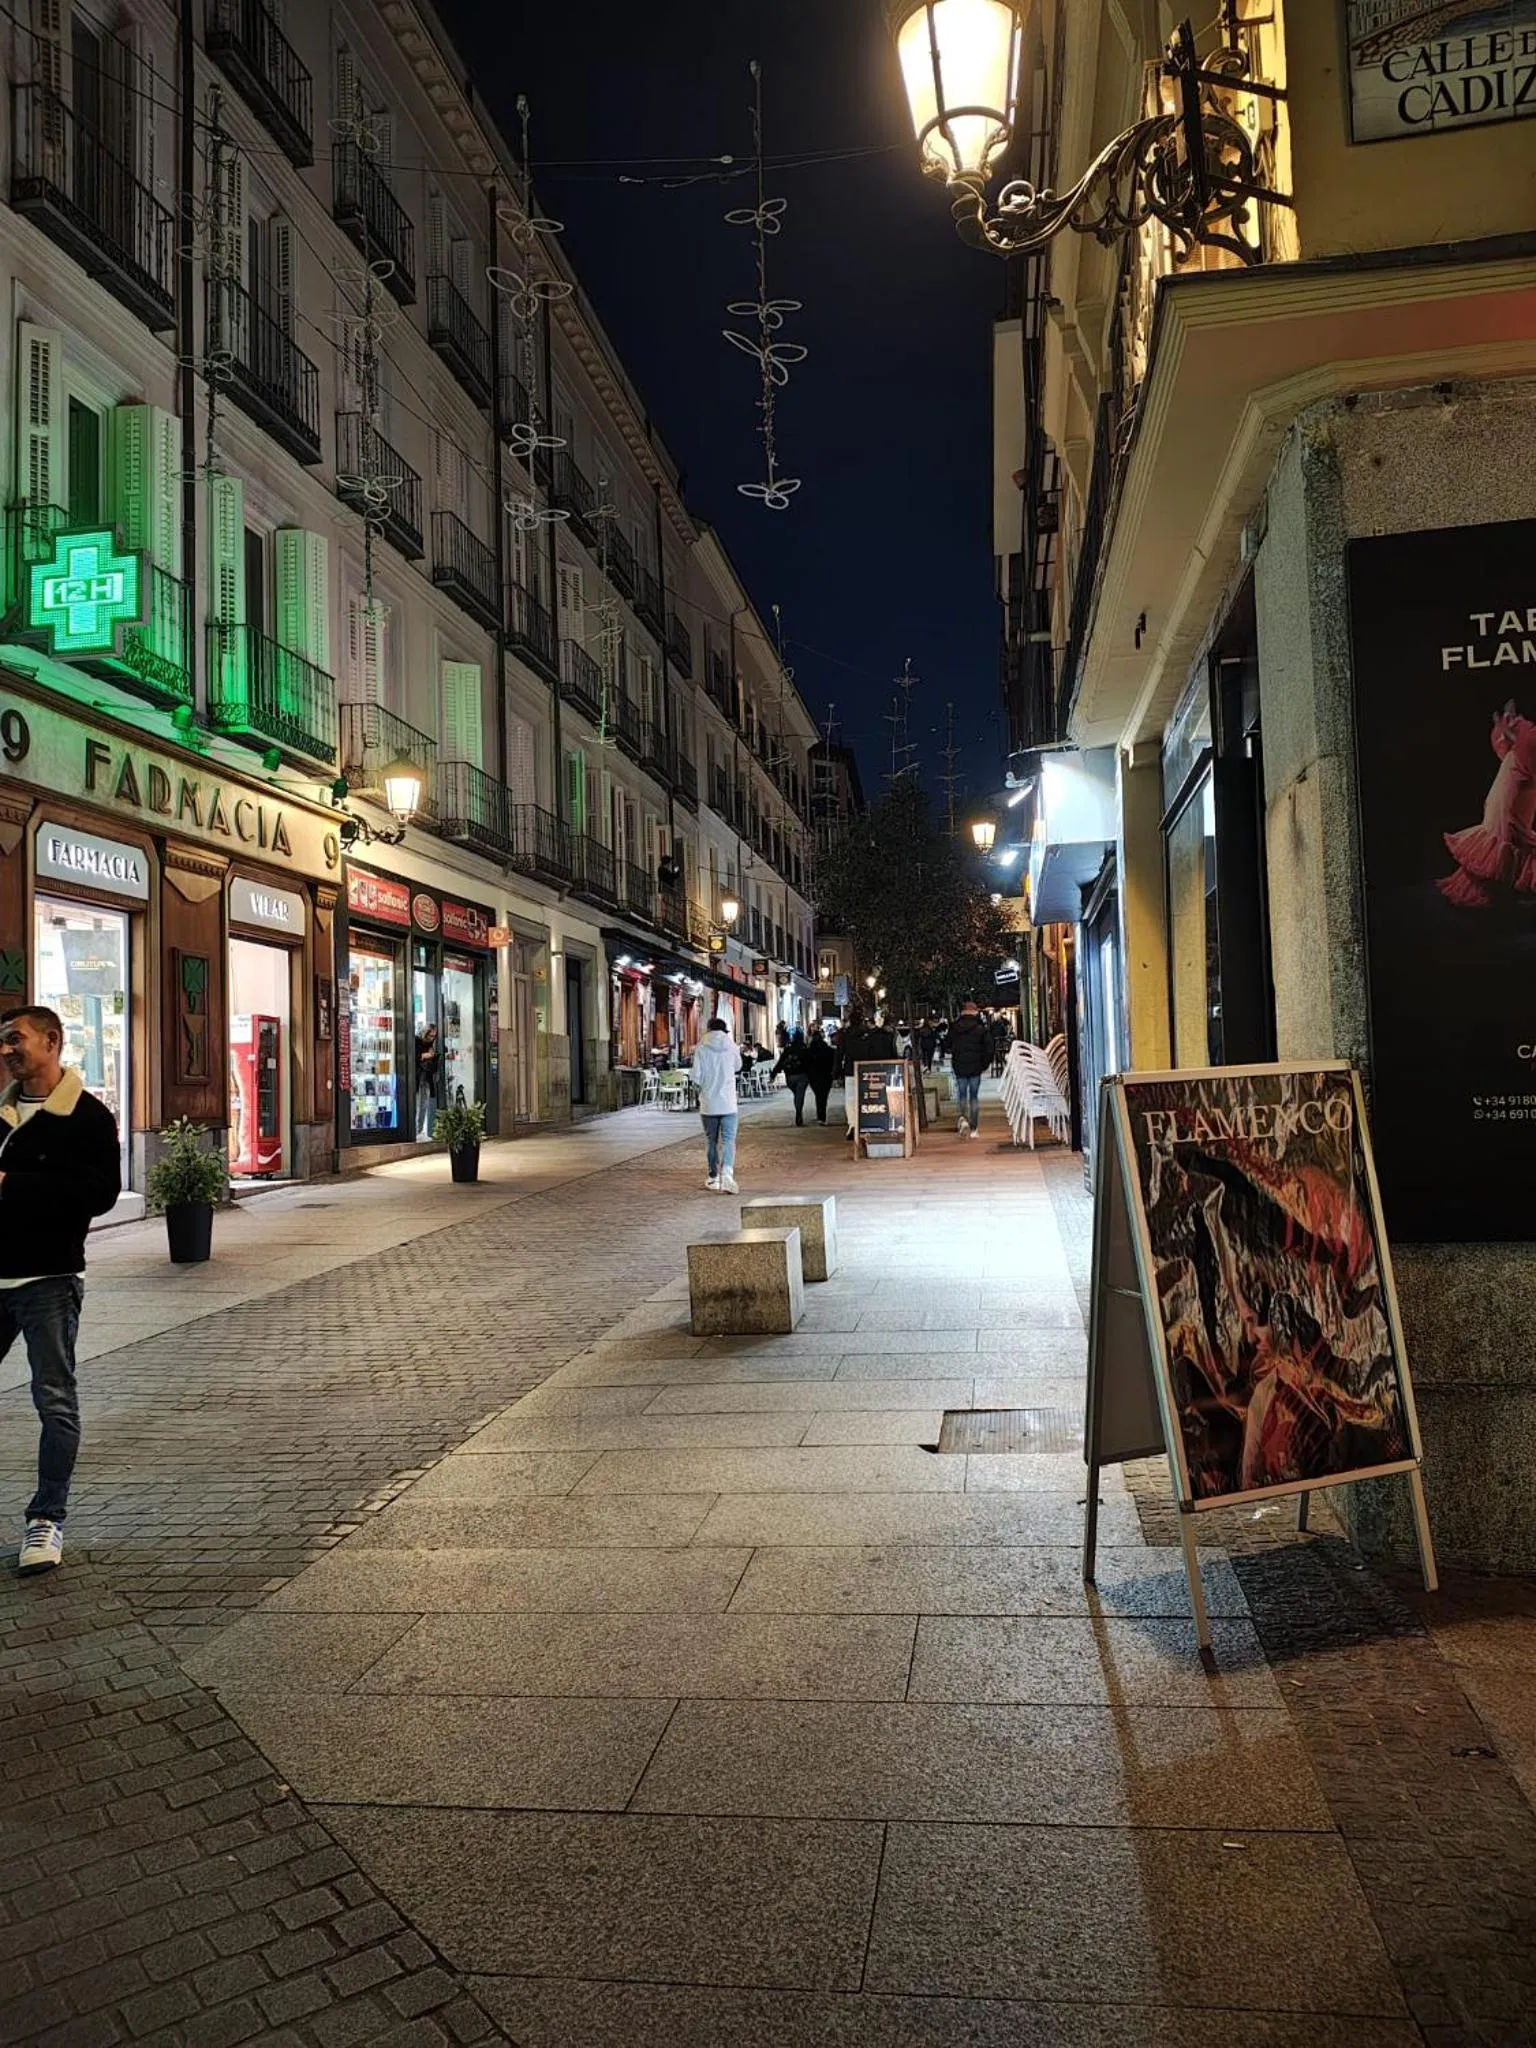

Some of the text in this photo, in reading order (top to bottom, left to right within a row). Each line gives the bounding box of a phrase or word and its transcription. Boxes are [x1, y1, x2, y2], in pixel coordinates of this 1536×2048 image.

[1382, 31, 1515, 82] CALLE
[1398, 64, 1536, 124] CADIZ
[55, 578, 112, 603] 12H
[1, 709, 340, 870] 9 FARMACIA 9
[48, 838, 140, 884] FARMACIA
[249, 892, 289, 921] VILAR
[1142, 1098, 1353, 1145] FLAMENCO
[1484, 1095, 1506, 1106] +34
[1485, 1109, 1506, 1120] +34
